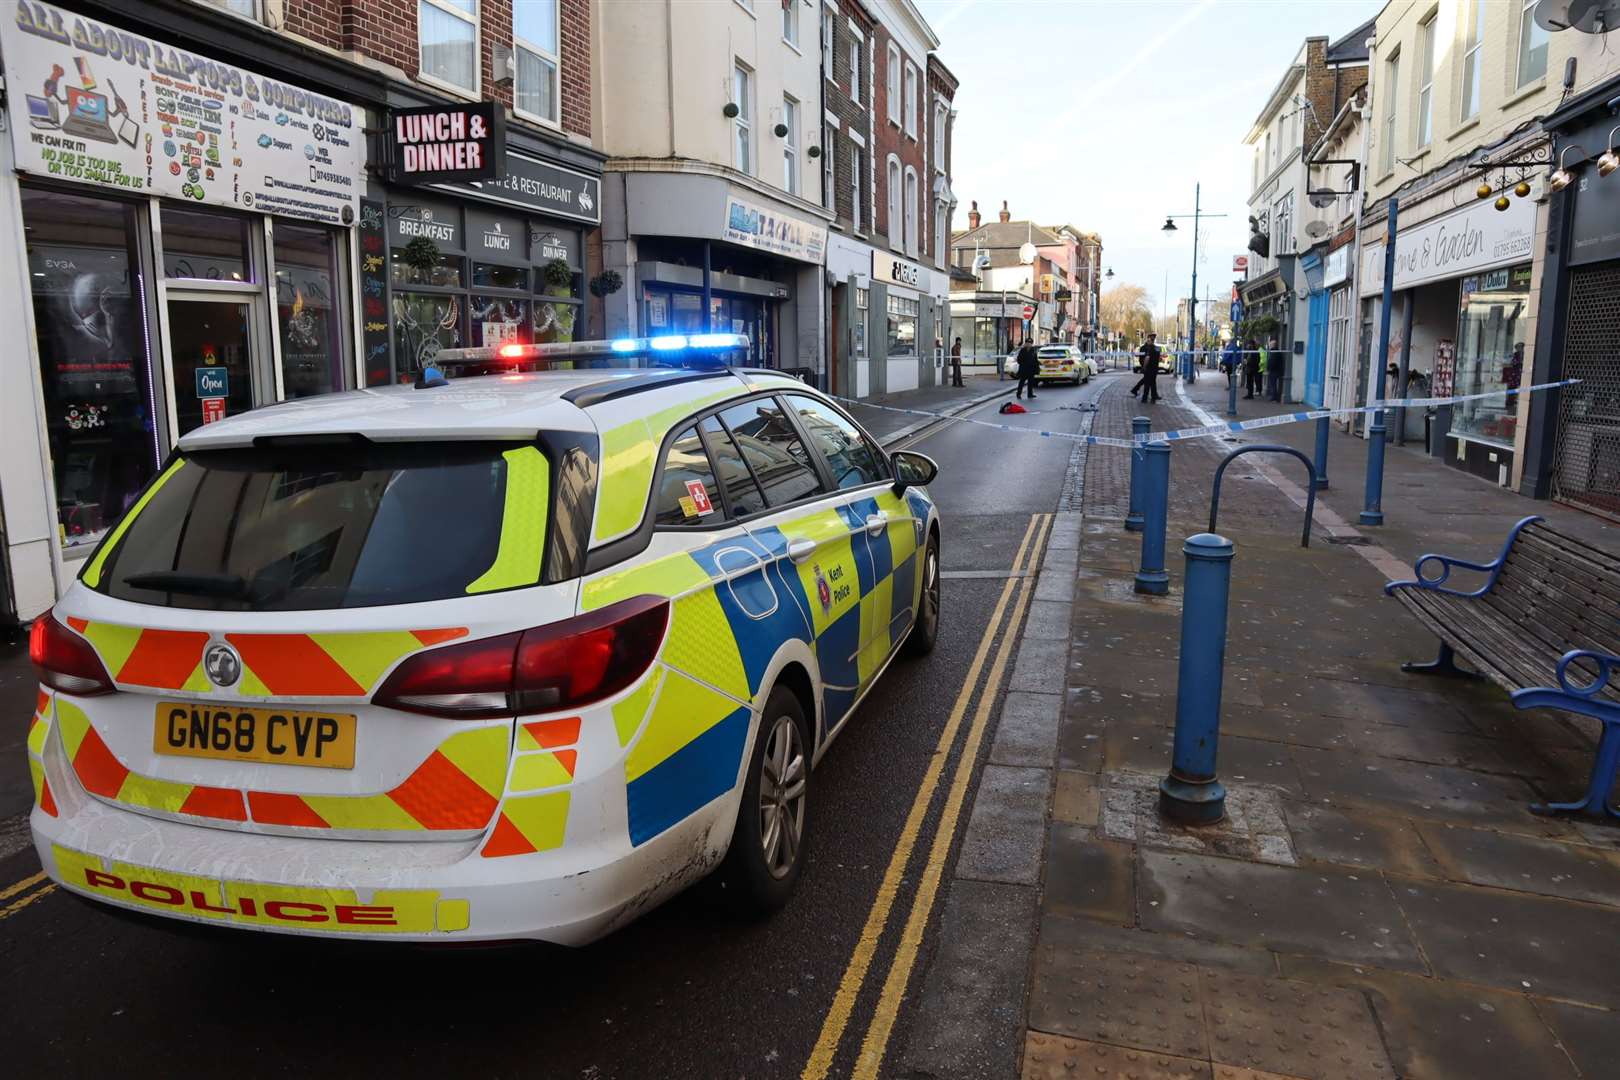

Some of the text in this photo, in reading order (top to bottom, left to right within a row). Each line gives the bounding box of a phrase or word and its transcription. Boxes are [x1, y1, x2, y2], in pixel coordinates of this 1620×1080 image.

[16, 0, 352, 128] ALL ABOUT LAPTOPS & COMPUTERS
[396, 111, 487, 144] LUNCH &
[30, 132, 44, 144] WE
[45, 136, 61, 147] CAN
[62, 139, 75, 150] FIX
[41, 148, 122, 174] NO JOB IS TOO BIG
[403, 141, 482, 173] DINNER
[47, 161, 143, 189] OR TOO SMALL FOR US
[511, 175, 519, 191] &
[520, 176, 572, 204] RESTAURANT
[399, 219, 454, 241] BREAKFAST
[484, 234, 510, 250] LUNCH
[1422, 237, 1431, 267] &
[1434, 217, 1484, 267] Garden
[542, 246, 568, 261] DINNER
[1486, 270, 1508, 289] Dulux
[201, 375, 223, 393] Open
[827, 563, 844, 583] Kent
[833, 584, 850, 605] Police
[168, 709, 339, 759] GN68 CVP
[84, 867, 398, 926] POLICE
